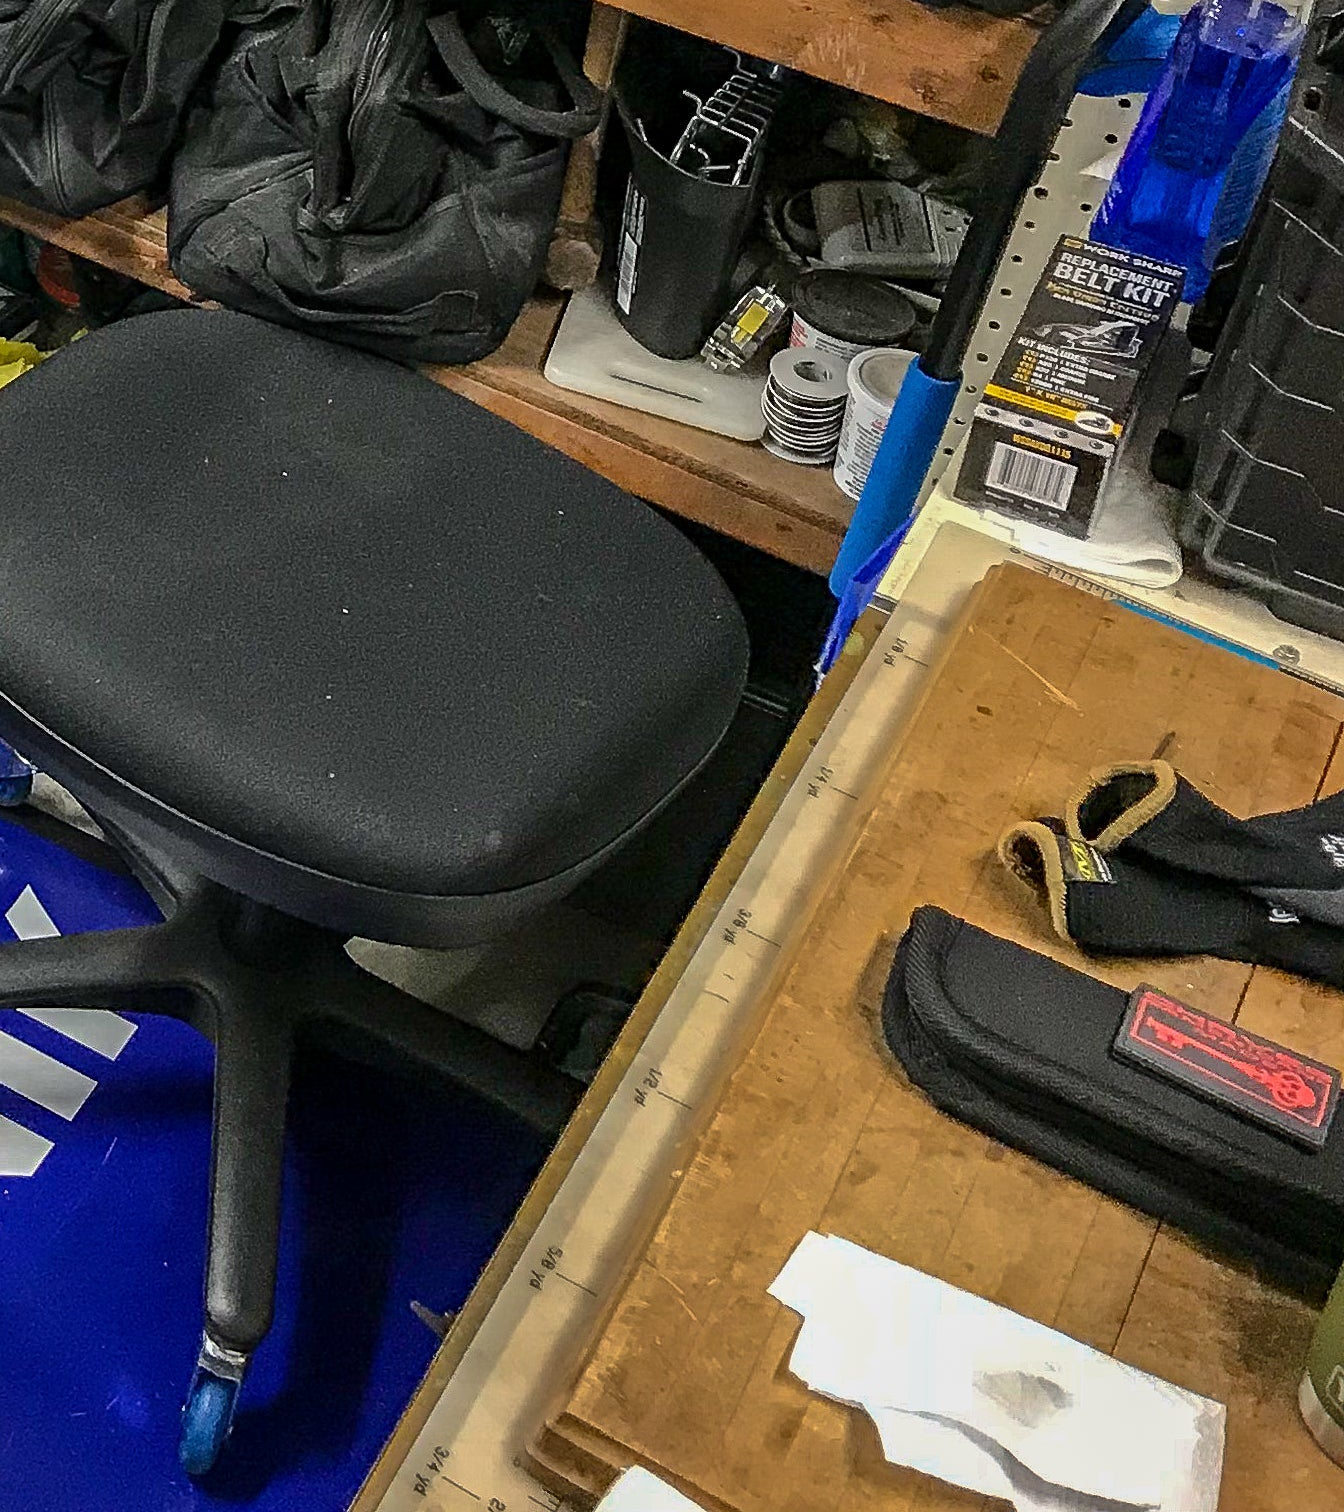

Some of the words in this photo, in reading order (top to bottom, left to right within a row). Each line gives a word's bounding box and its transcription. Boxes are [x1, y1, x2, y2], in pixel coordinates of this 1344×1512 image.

[1060, 251, 1175, 292] REPLACEMENT
[1083, 243, 1131, 264] WORK
[1132, 258, 1184, 279] SHARP
[1053, 260, 1122, 295] BELT
[1122, 282, 1171, 308] KIT
[1018, 336, 1036, 349] KIT
